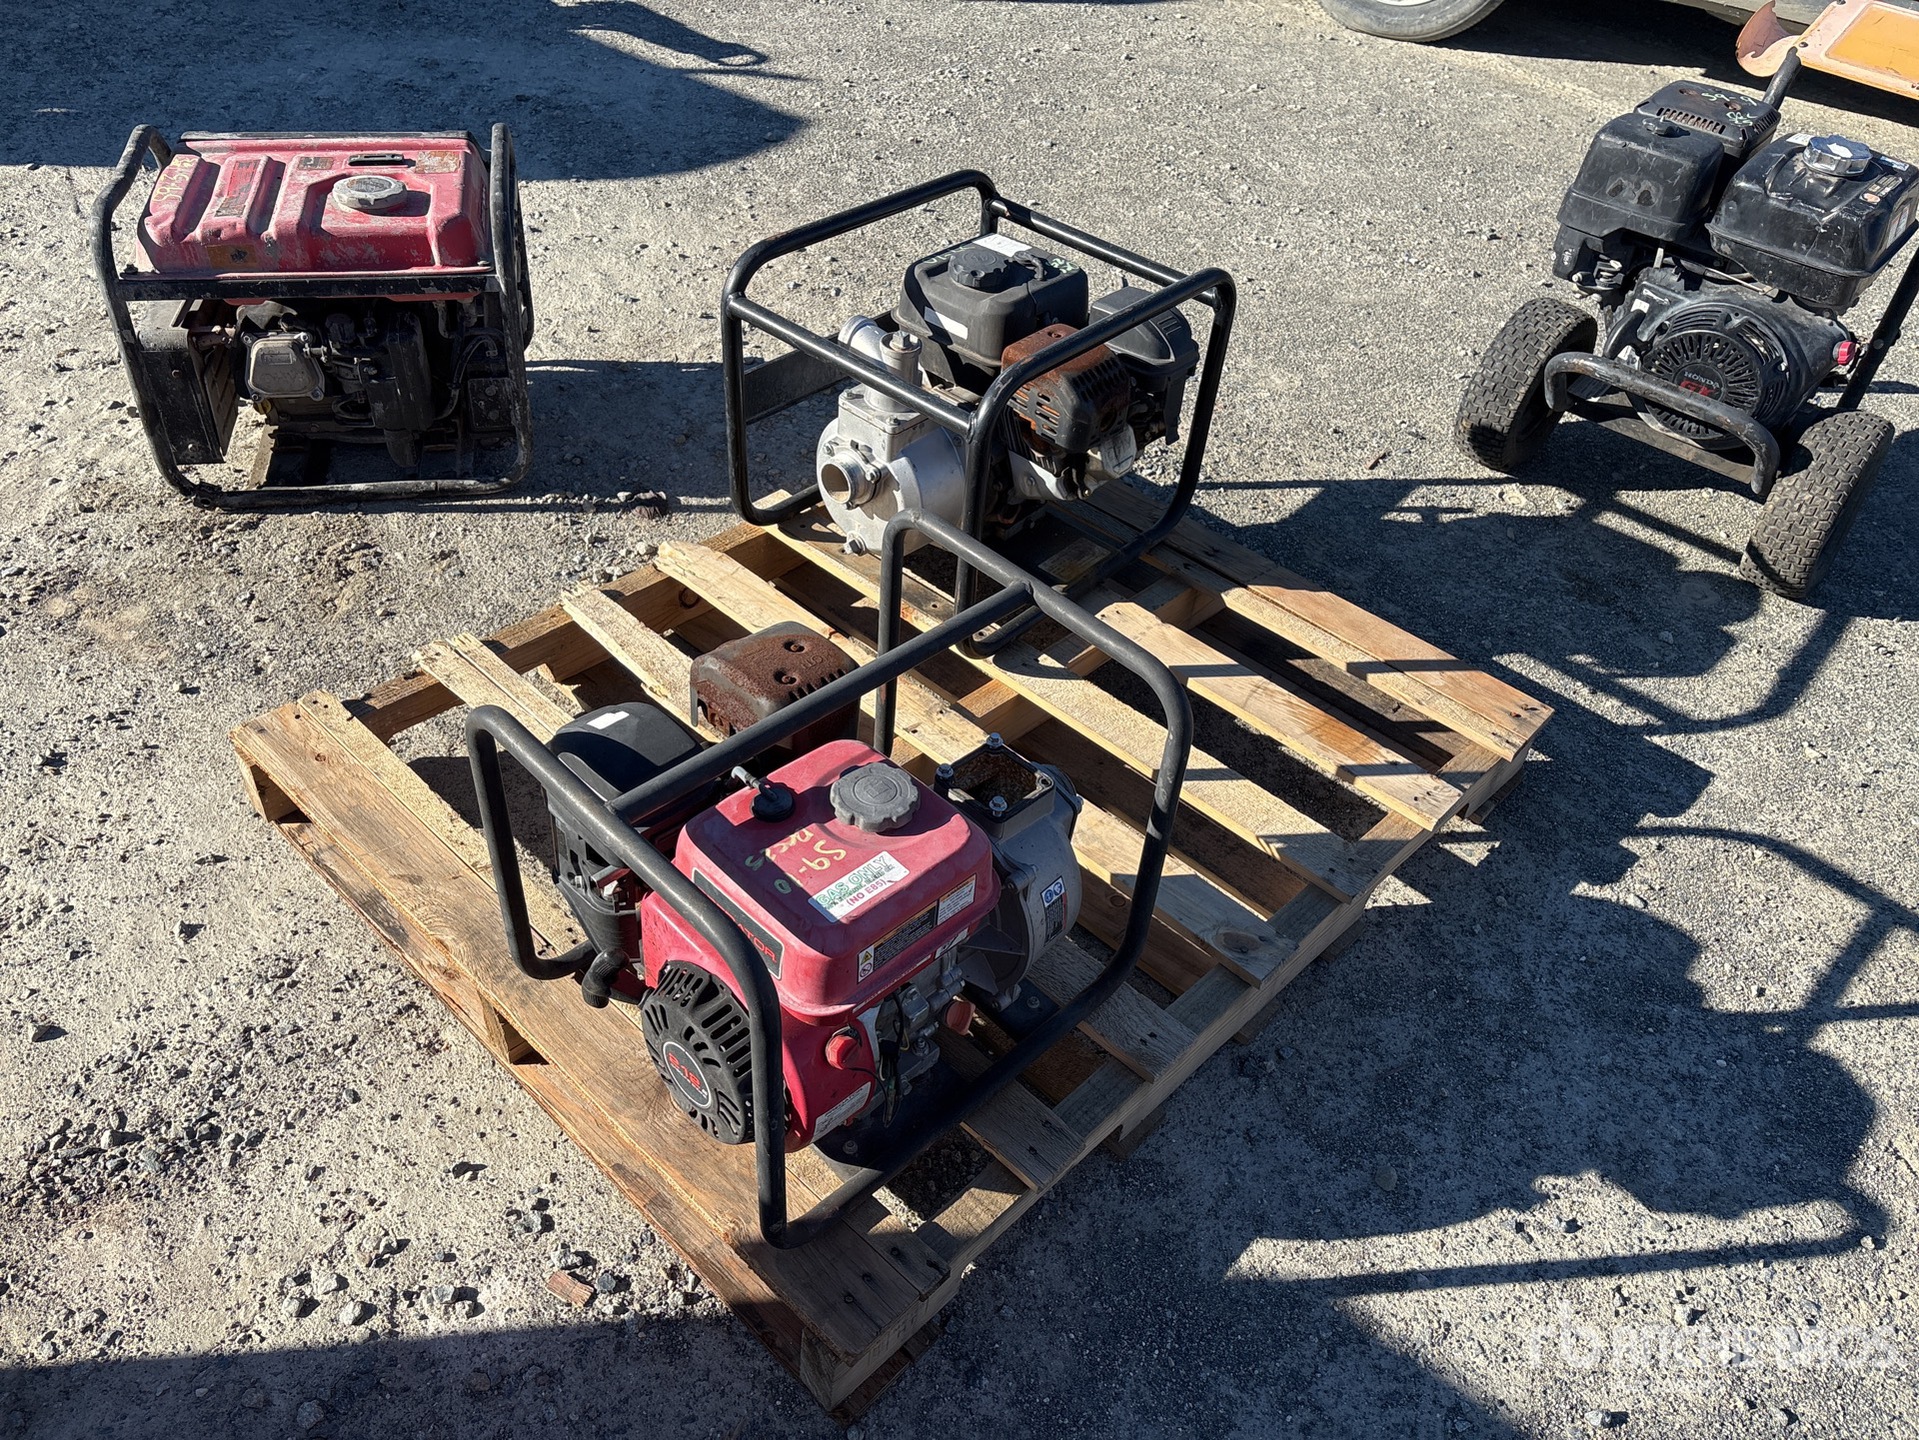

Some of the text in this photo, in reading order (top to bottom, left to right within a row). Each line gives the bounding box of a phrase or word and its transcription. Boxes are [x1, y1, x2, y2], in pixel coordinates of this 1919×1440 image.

[1701, 92, 1757, 106] 59-9
[1684, 371, 1720, 389] HONDA
[816, 881, 850, 907] GAS
[848, 855, 889, 887] ONLY
[846, 879, 888, 907] (NO E85)
